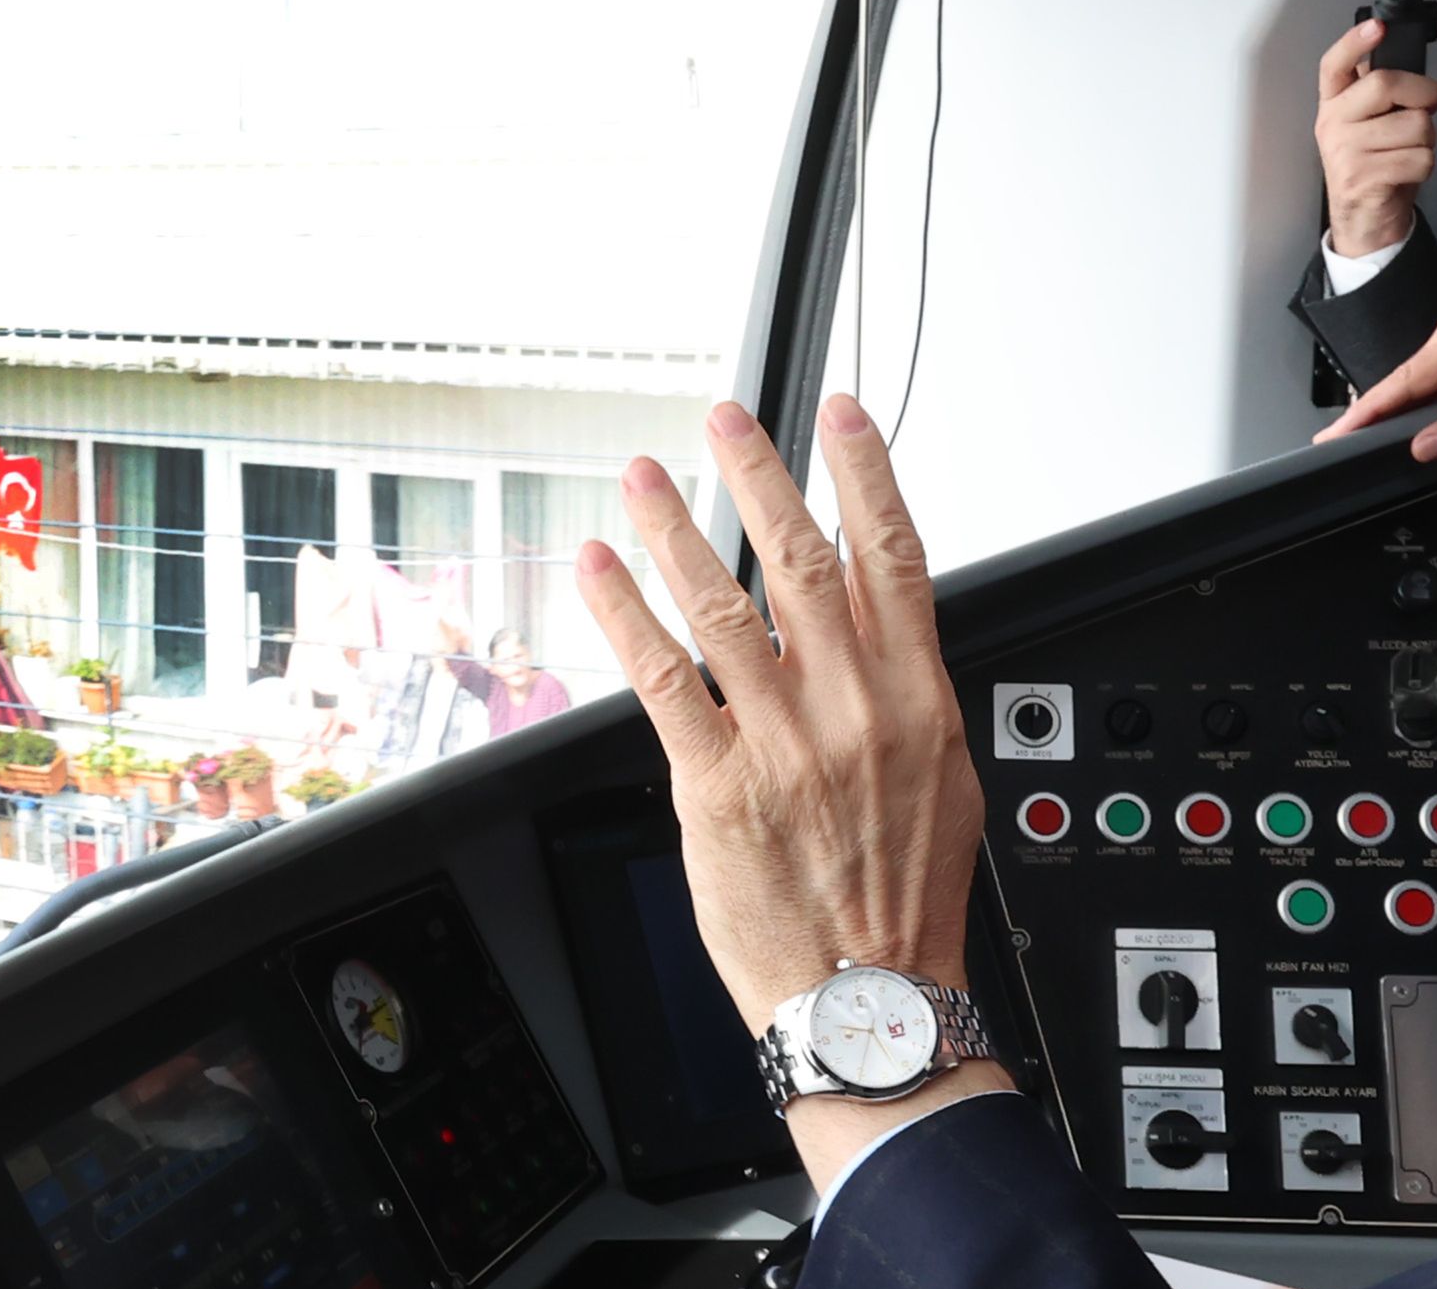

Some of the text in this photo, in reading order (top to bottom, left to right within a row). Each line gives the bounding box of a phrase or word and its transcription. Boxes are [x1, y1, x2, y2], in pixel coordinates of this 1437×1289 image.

[1179, 846, 1204, 856] PARK
[1259, 847, 1286, 857] PARK
[1302, 961, 1325, 972] FAN
[1328, 962, 1350, 973] HIZI
[1290, 1085, 1341, 1098] SICAKLIK
[1344, 1086, 1378, 1099] AYARI
